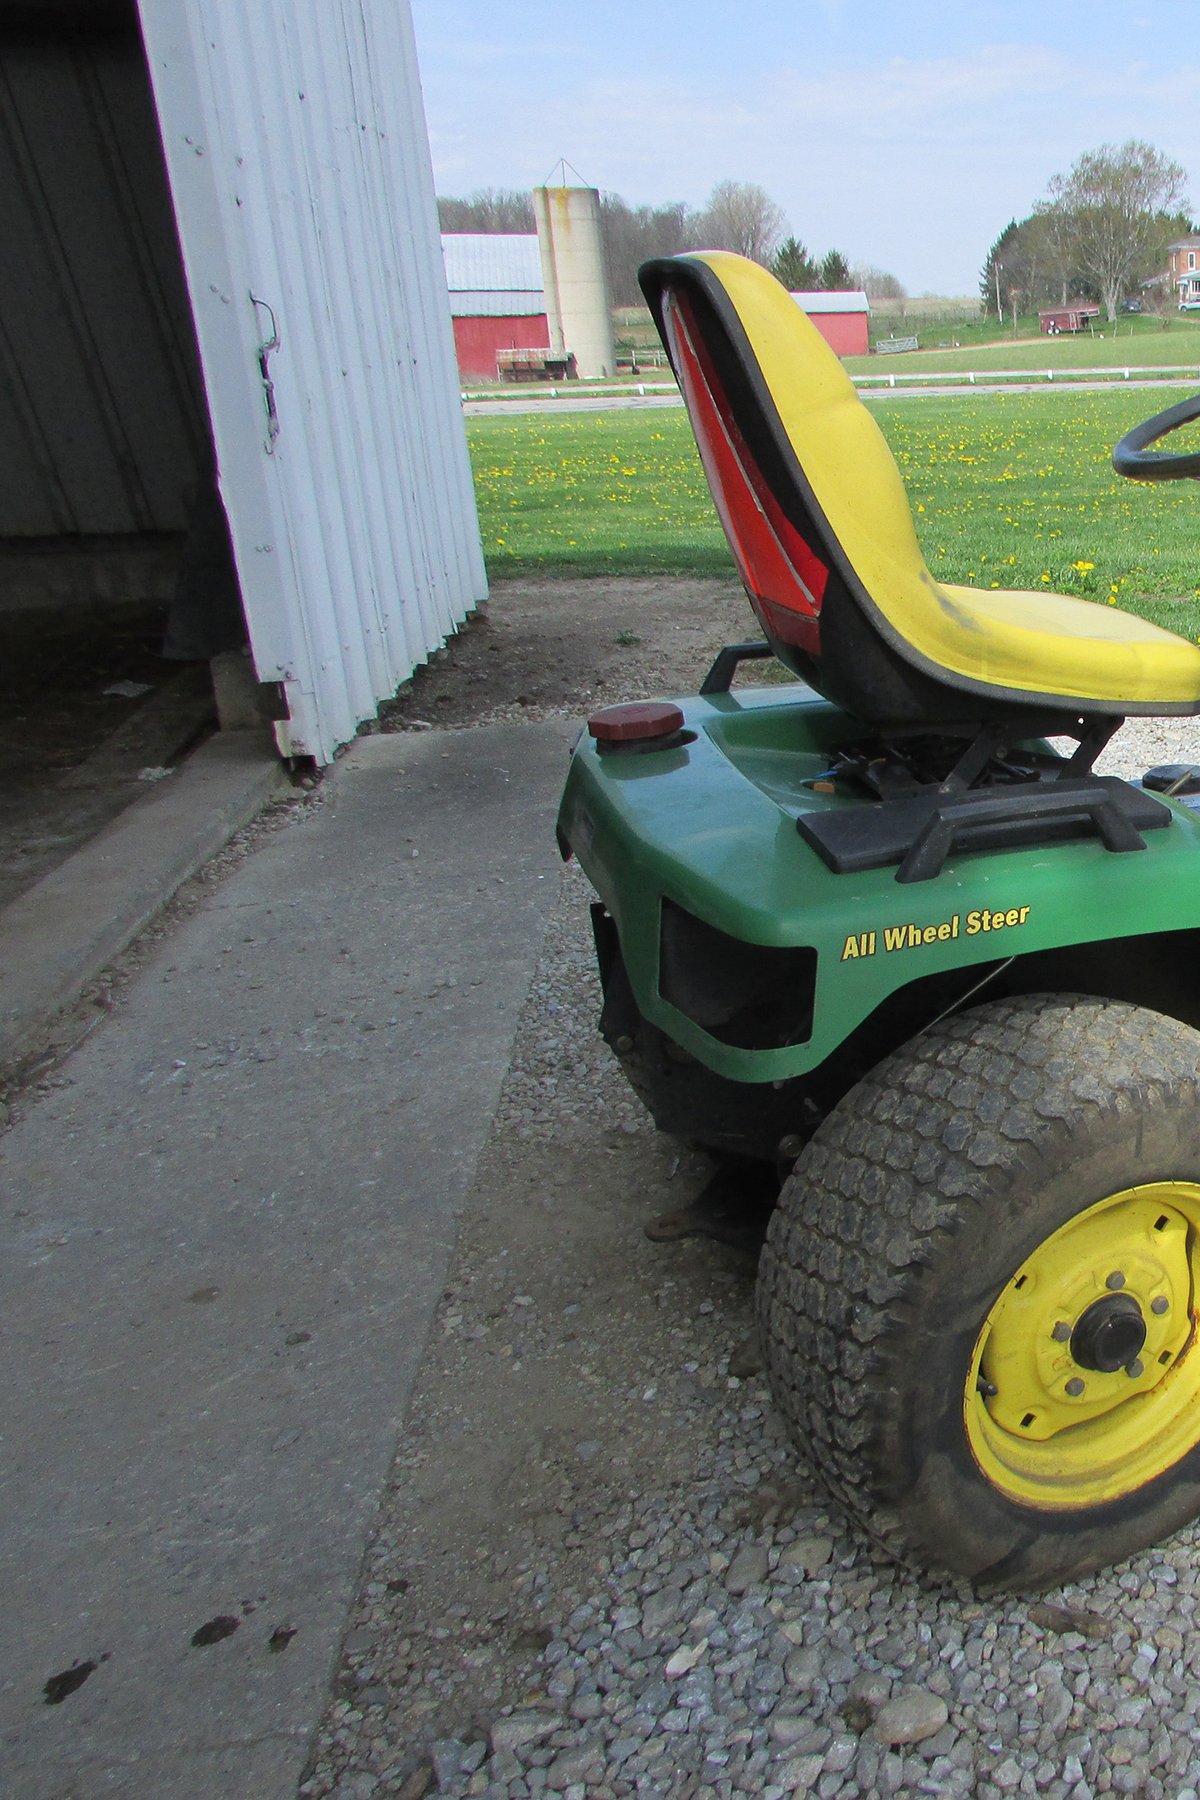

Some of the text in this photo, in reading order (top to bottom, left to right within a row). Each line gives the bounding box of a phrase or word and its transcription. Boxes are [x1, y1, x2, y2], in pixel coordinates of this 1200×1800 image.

[840, 904, 1031, 962] All Wheel Steer
